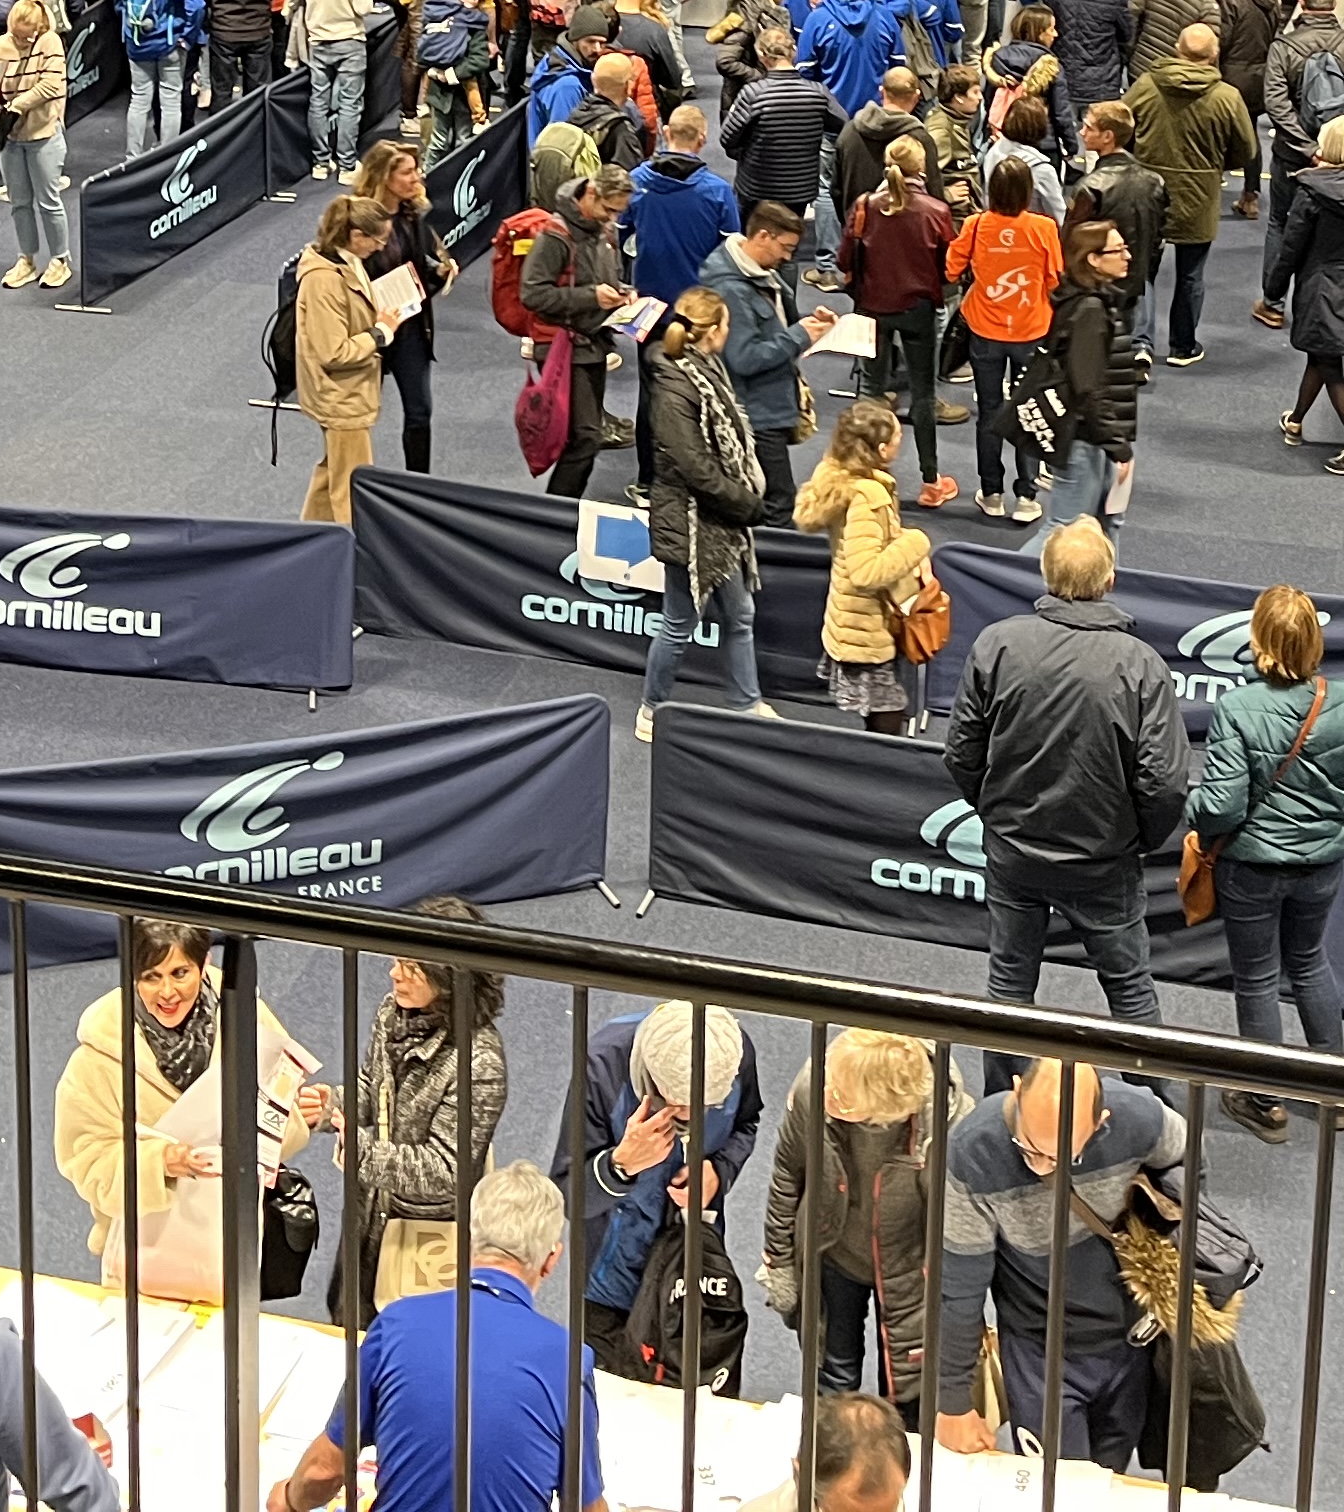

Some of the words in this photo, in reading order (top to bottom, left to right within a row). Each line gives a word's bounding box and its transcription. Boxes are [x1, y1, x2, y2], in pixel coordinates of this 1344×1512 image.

[149, 185, 218, 239] cornilleau
[521, 594, 720, 648] cornilleu
[297, 875, 383, 898] FRANCE
